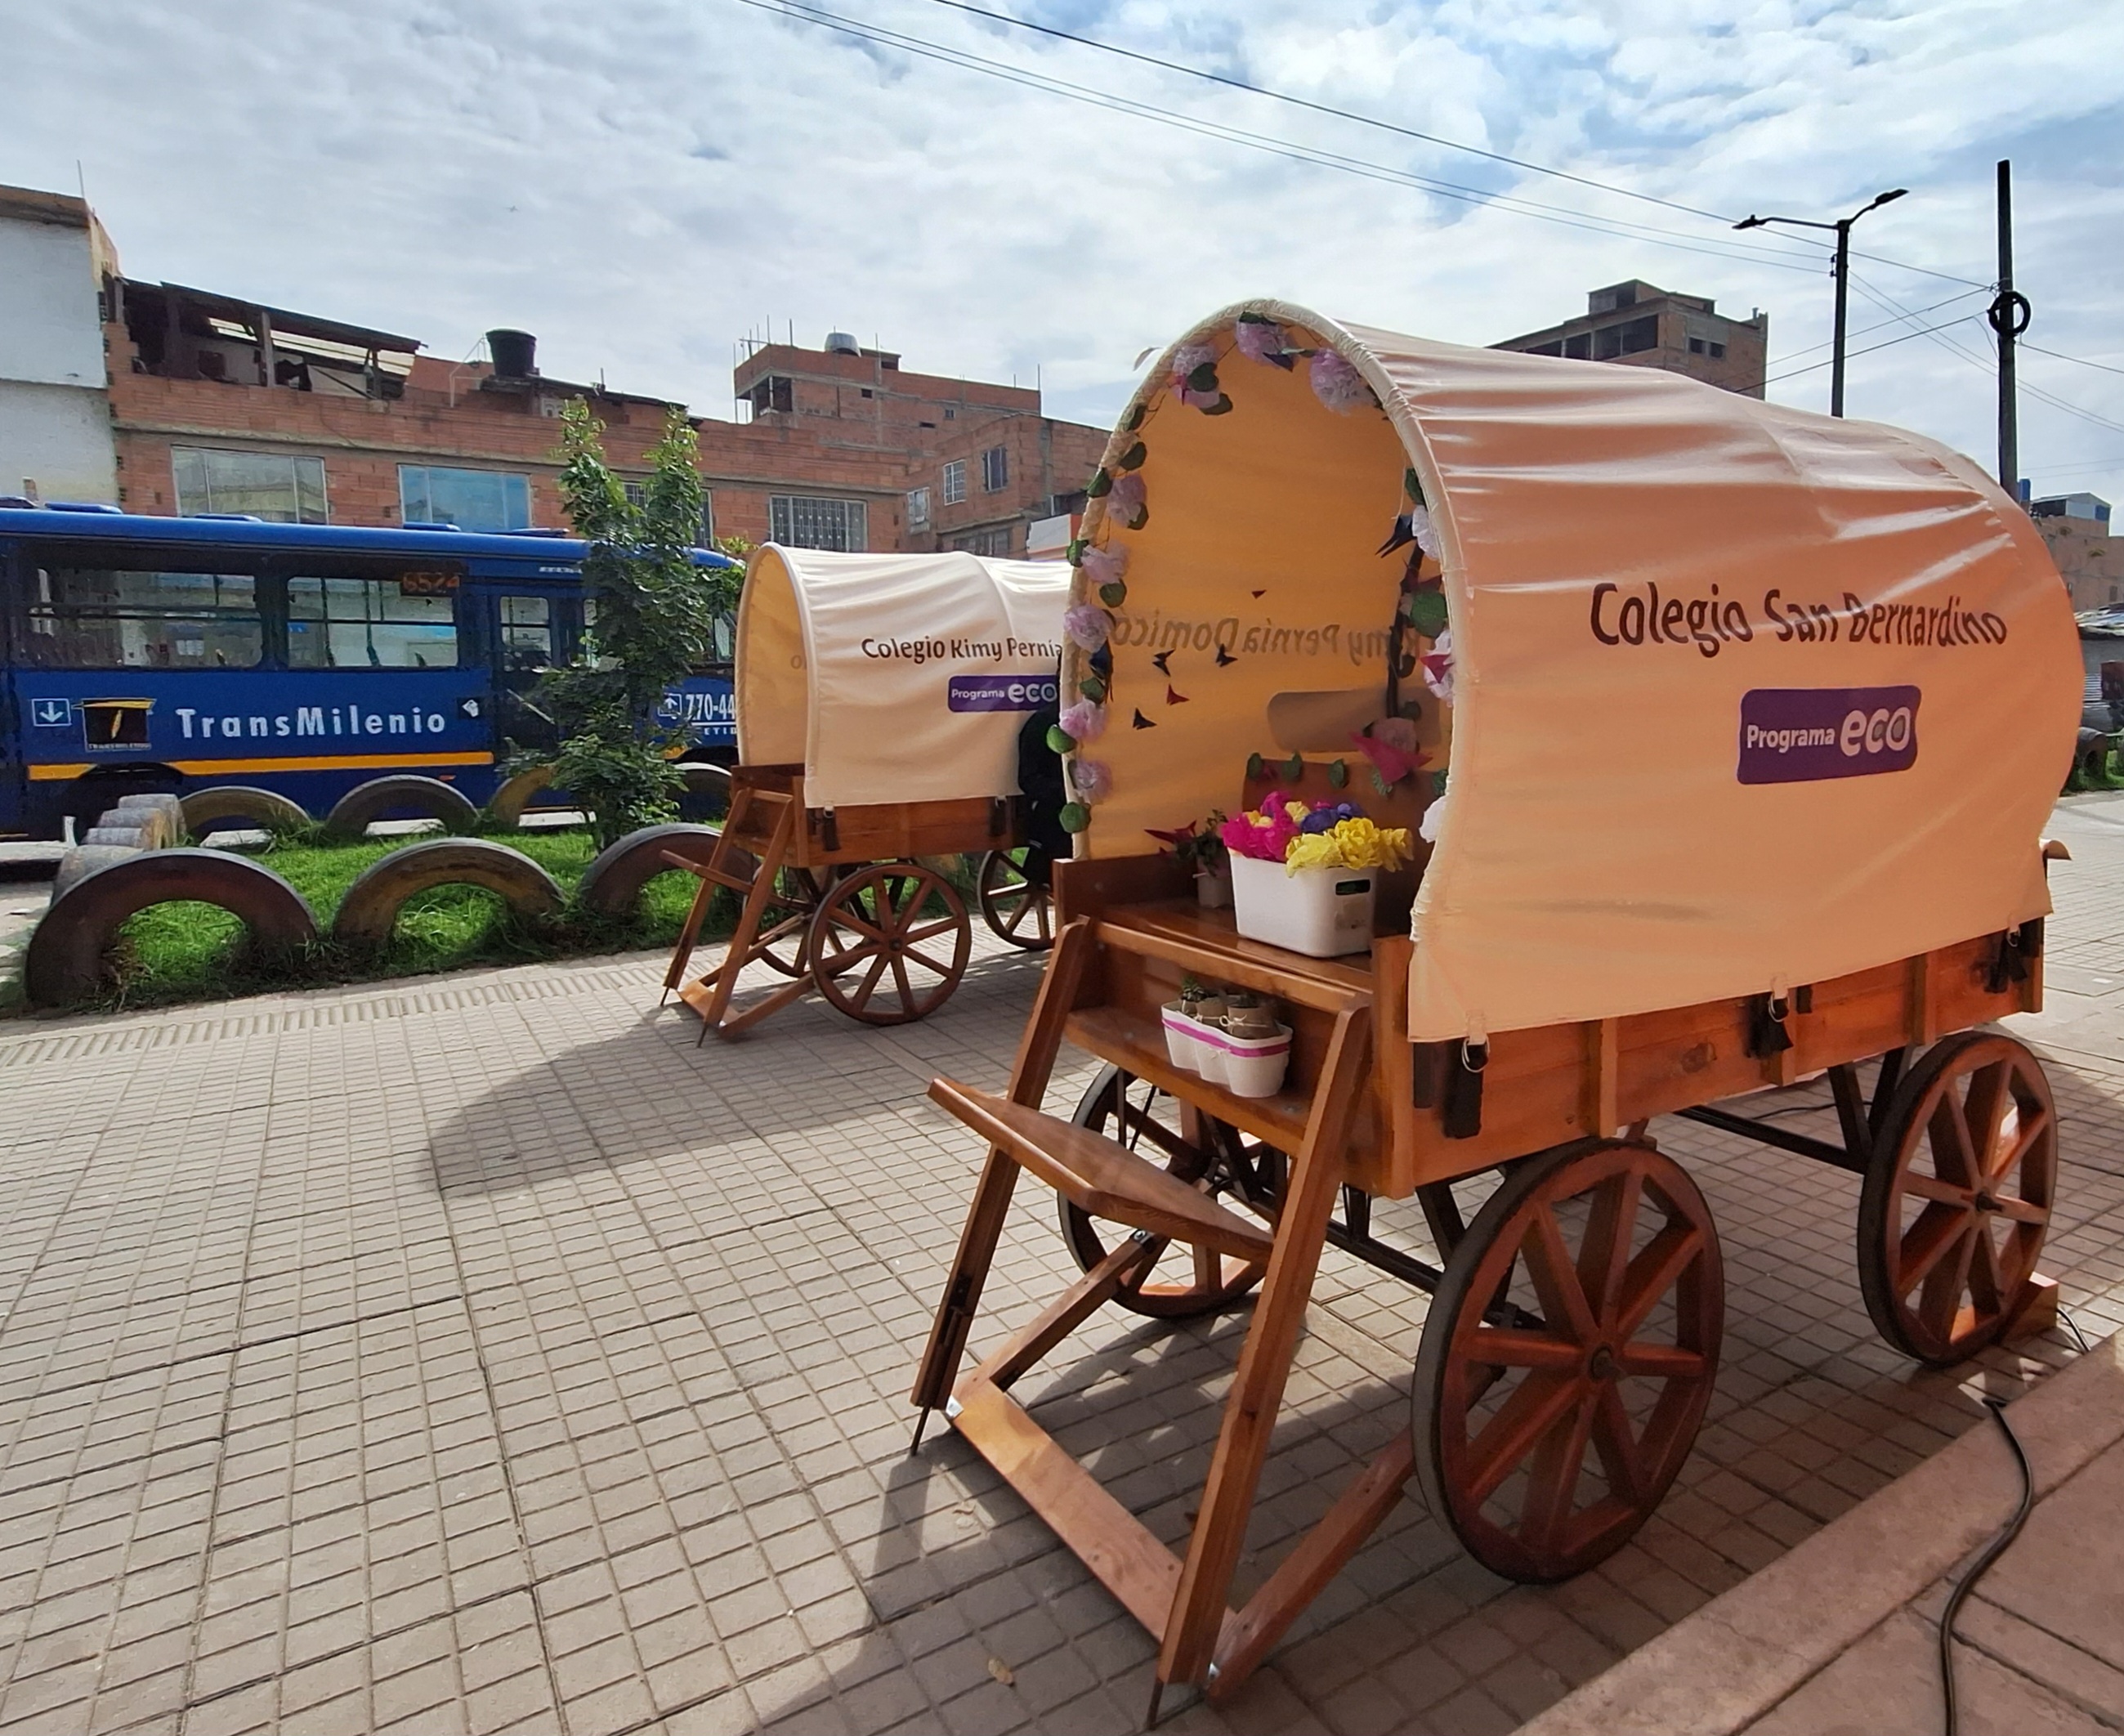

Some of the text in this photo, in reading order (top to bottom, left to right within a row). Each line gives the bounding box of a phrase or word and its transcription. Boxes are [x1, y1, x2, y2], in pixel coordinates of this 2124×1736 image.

[1590, 581, 2007, 658] Colegio San Bernardino
[861, 636, 945, 664] Colegio
[950, 638, 1002, 662] Kimy
[951, 683, 1058, 702] Programa eco
[175, 705, 445, 738] TransMilenio
[1746, 706, 1911, 757] Programa eco
